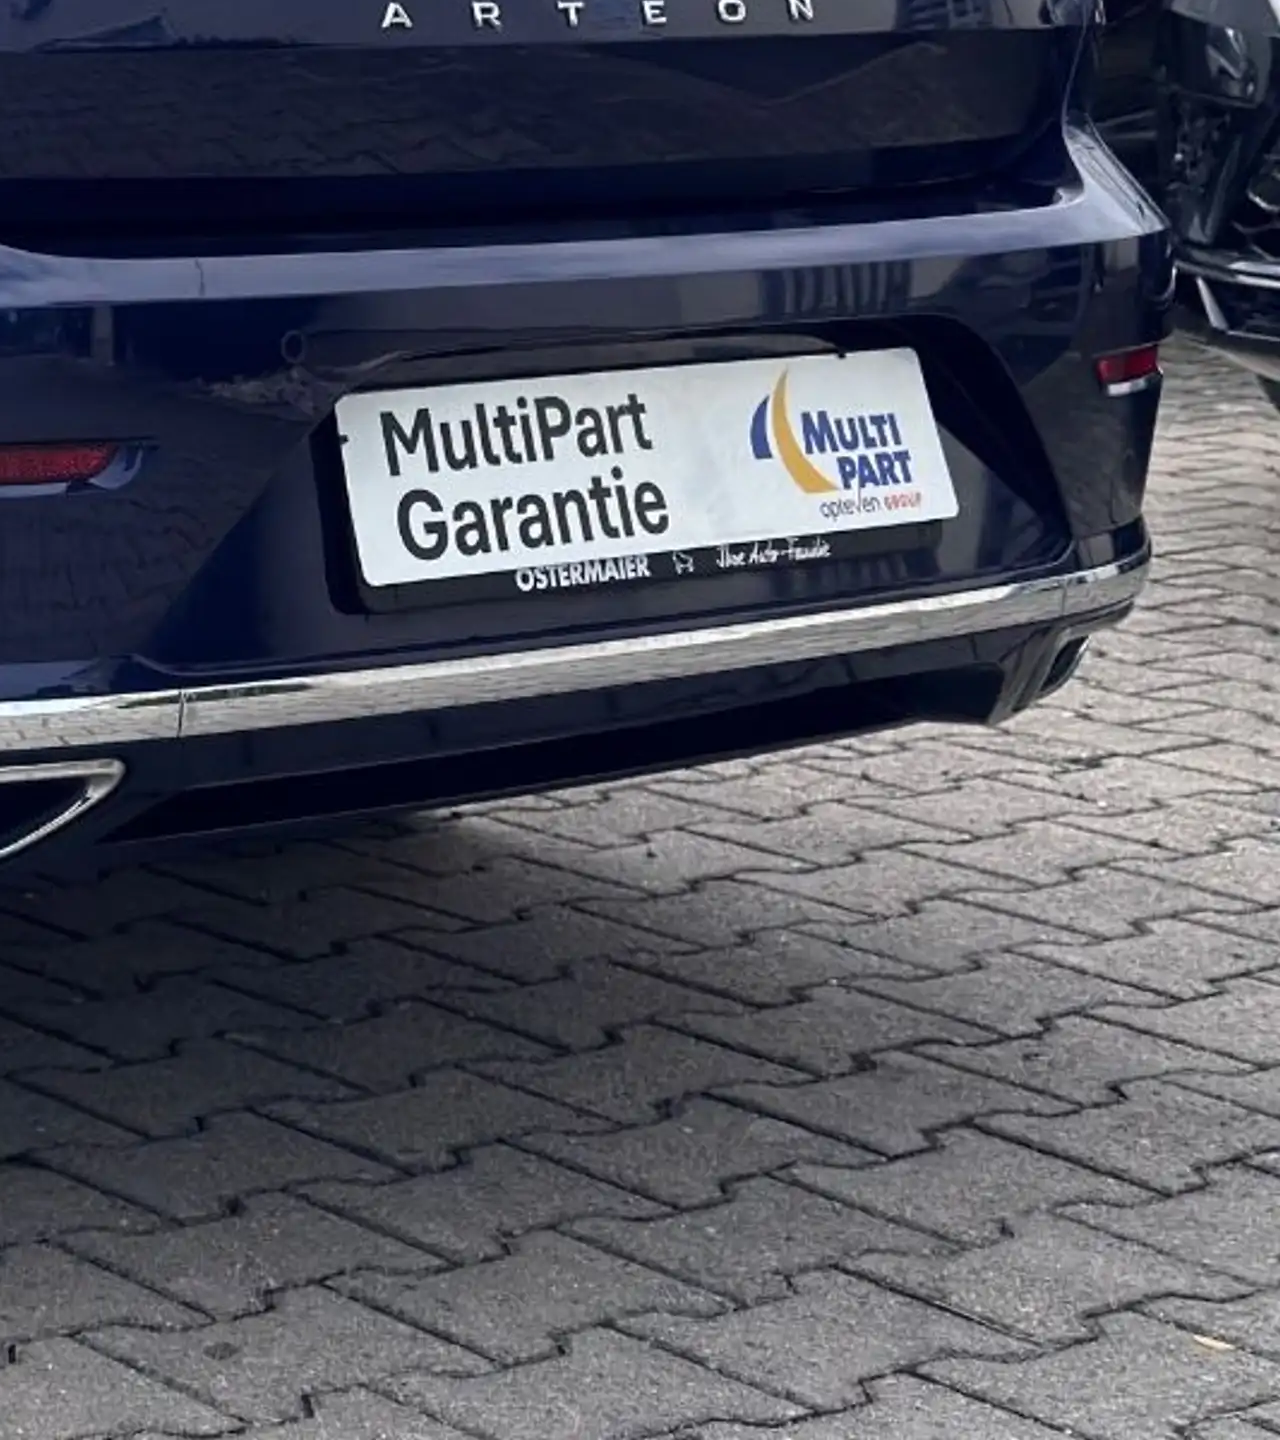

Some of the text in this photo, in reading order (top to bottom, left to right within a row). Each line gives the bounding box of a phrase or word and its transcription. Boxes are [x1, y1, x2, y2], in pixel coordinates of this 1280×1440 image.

[380, 394, 653, 476] MultiPart
[801, 411, 902, 454] MULTI
[836, 449, 912, 490] PART
[397, 465, 670, 561] Garantie
[515, 555, 652, 591] OSTERMAIER
